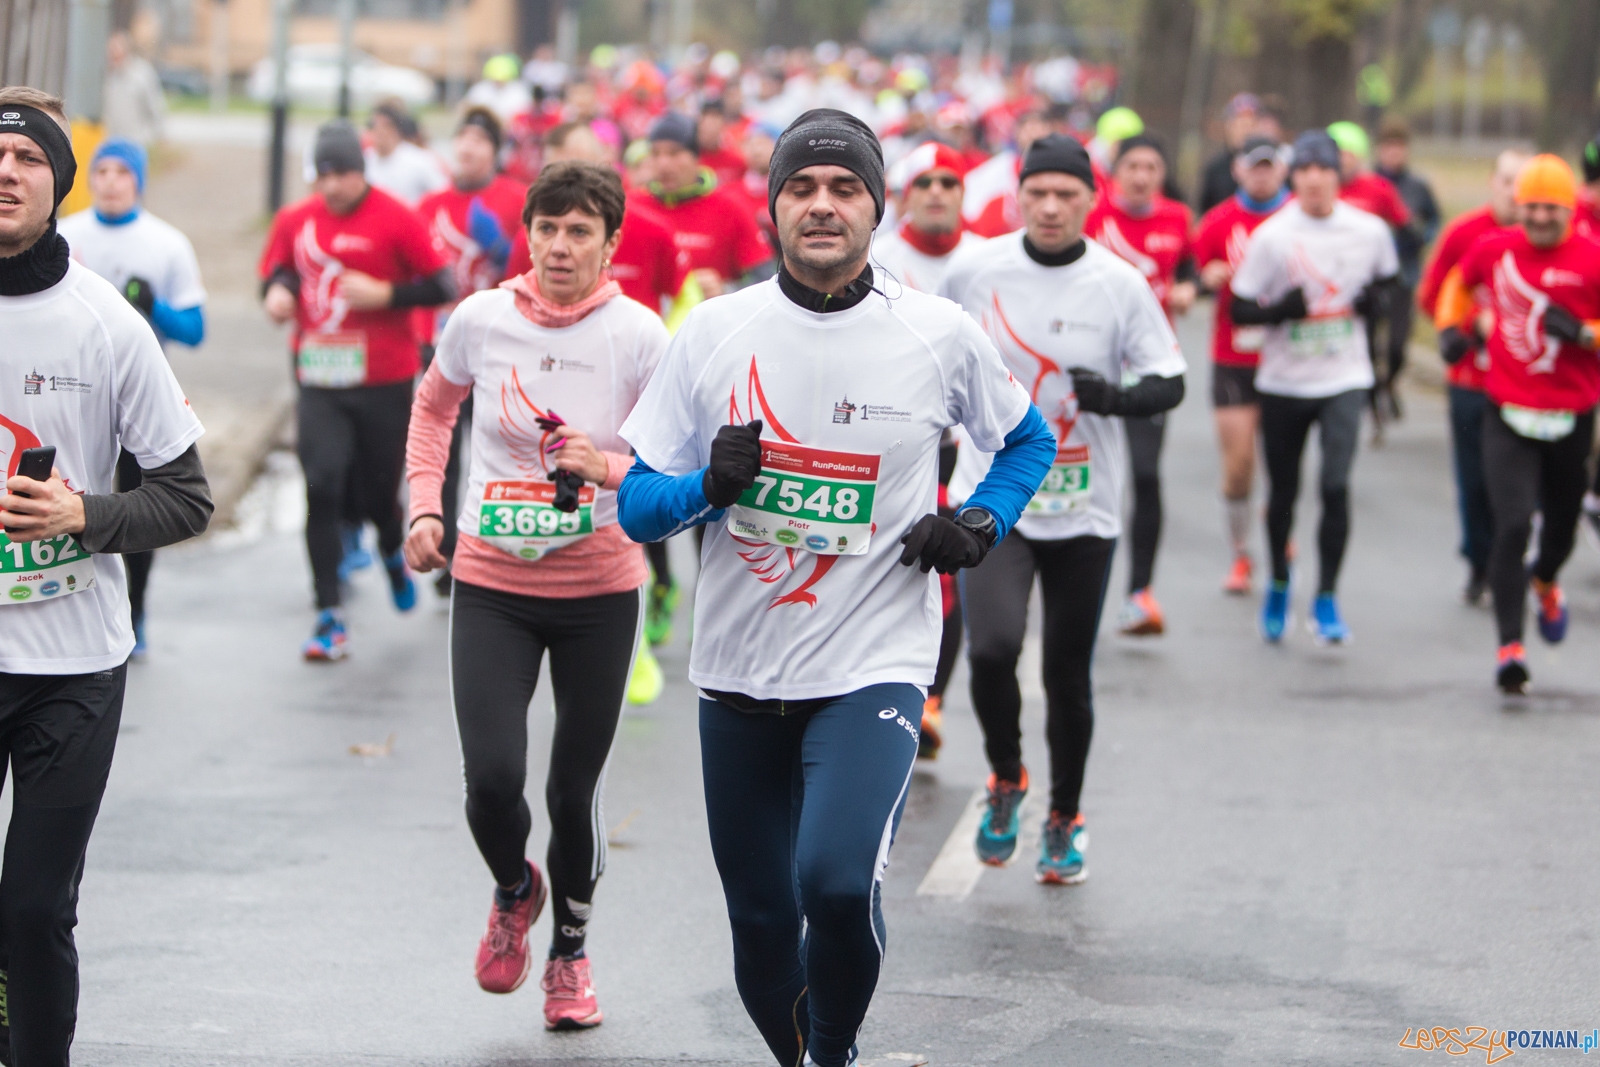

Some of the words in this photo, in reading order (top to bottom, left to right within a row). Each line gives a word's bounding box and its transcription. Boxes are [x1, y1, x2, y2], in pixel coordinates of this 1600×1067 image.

[0, 119, 26, 127] alenji
[817, 138, 848, 147] HI-TEC
[49, 375, 57, 391] 1
[860, 404, 869, 421] 1
[765, 450, 772, 462] 1
[812, 460, 871, 475] RunPoland.org
[1042, 468, 1083, 491] 93
[754, 475, 860, 520] 7548
[493, 506, 581, 535] 3695
[788, 519, 811, 531] Piotr
[0, 533, 78, 568] 162
[16, 573, 44, 582] Jacek
